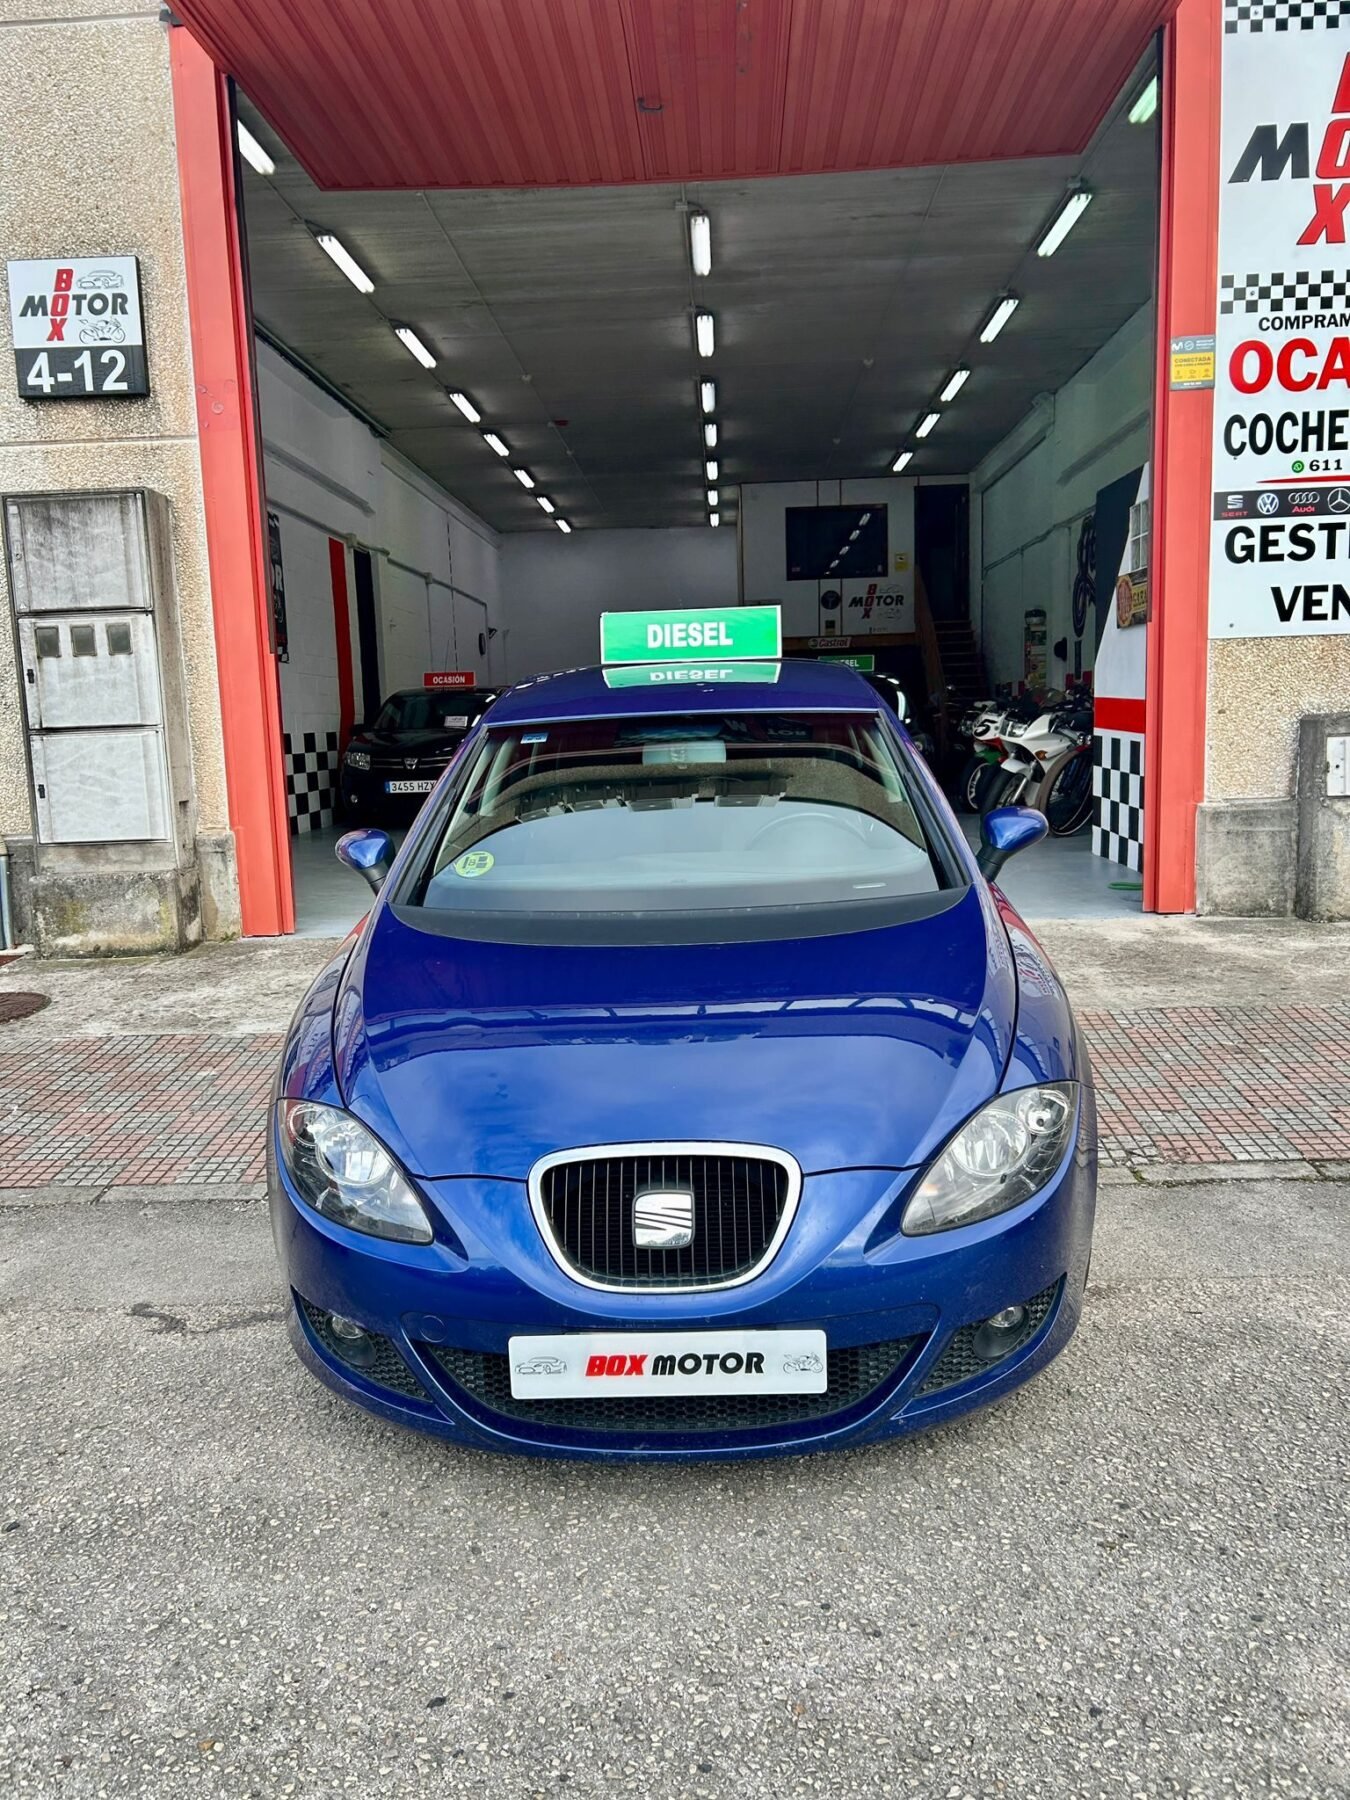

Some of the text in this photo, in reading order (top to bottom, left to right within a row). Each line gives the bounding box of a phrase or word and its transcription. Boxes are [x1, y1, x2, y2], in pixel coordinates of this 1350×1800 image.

[19, 293, 129, 317] MOTOR
[46, 268, 74, 342] BOX
[26, 349, 129, 393] 4-12
[1229, 337, 1350, 394] OCA
[1224, 409, 1350, 457] COCHE
[1309, 458, 1343, 471] 611
[1291, 505, 1316, 513] Audi
[1224, 522, 1350, 564] GEST
[848, 594, 904, 608] MOTOR
[861, 584, 877, 619] BOX
[647, 621, 733, 649] DIESEL
[819, 638, 849, 648] Castrol
[432, 674, 466, 685] OCASIÓN
[973, 718, 998, 737] 5
[391, 782, 415, 792] 3455
[585, 1351, 765, 1377] BOX MOTOR
